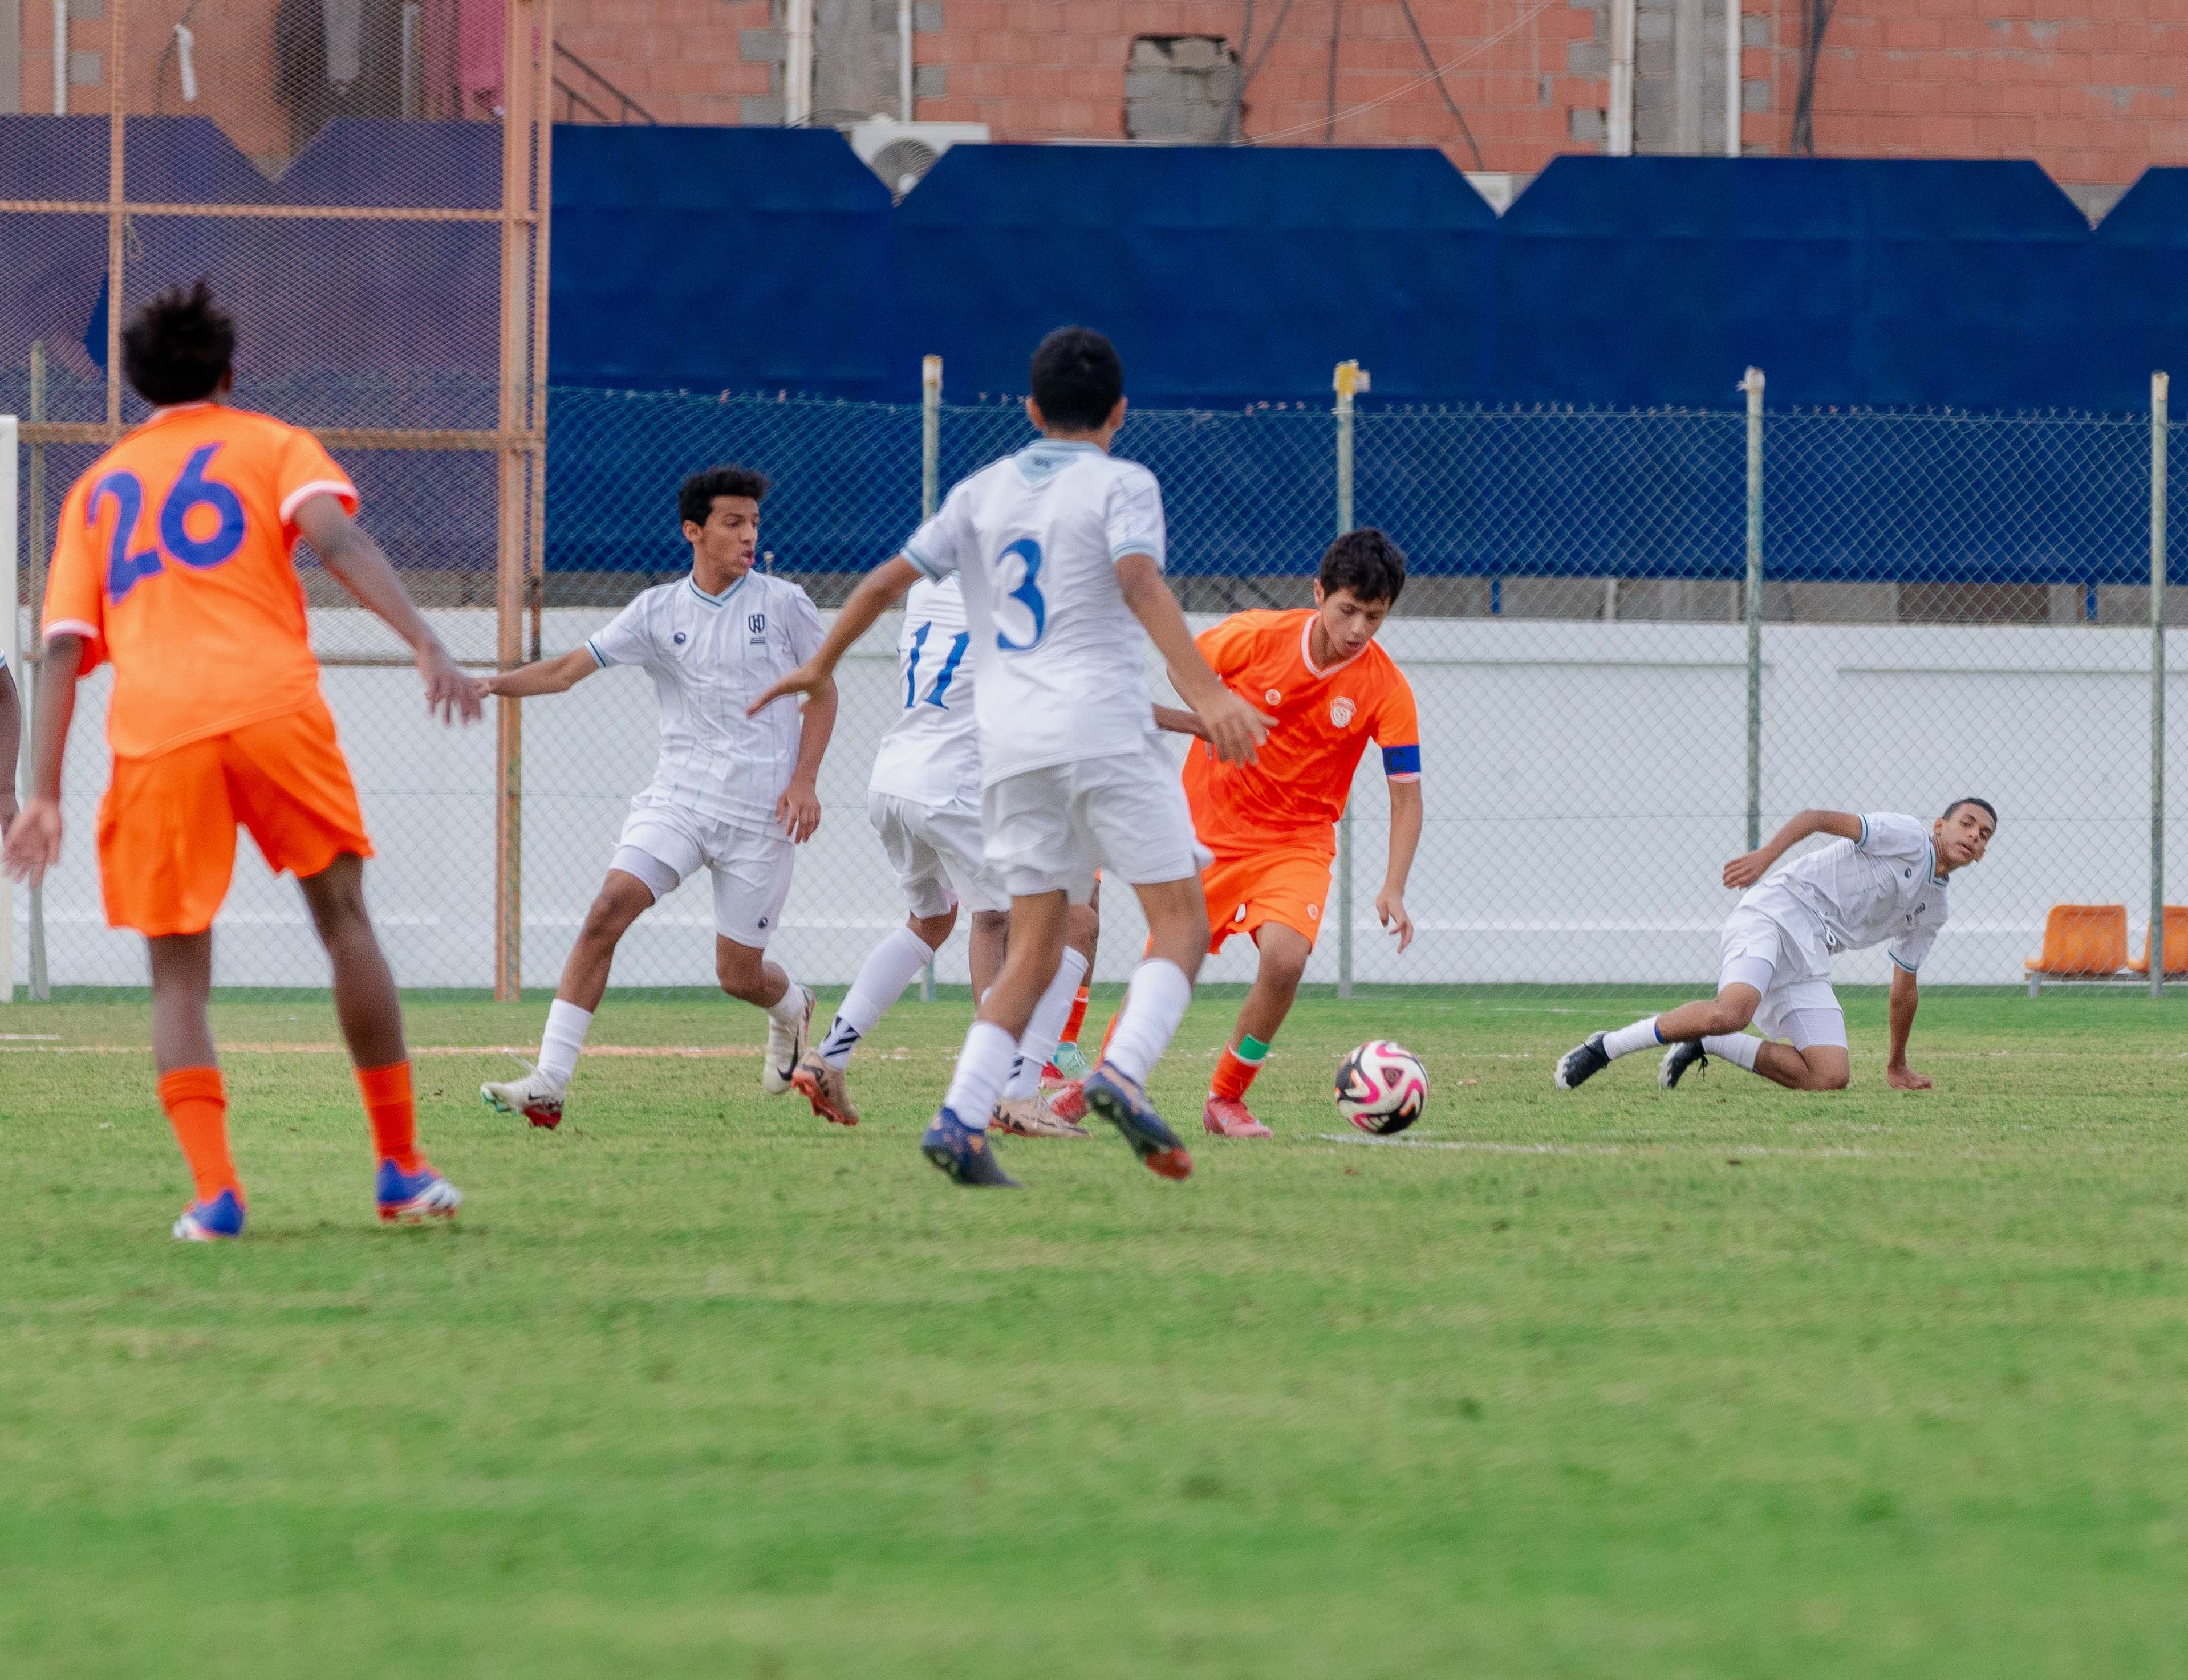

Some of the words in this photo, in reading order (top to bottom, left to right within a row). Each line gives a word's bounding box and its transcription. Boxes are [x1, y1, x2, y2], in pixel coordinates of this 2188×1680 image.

[86, 442, 247, 607] 26
[995, 537, 1045, 652] 3
[904, 621, 971, 710] 11
[1386, 750, 1405, 771] C
